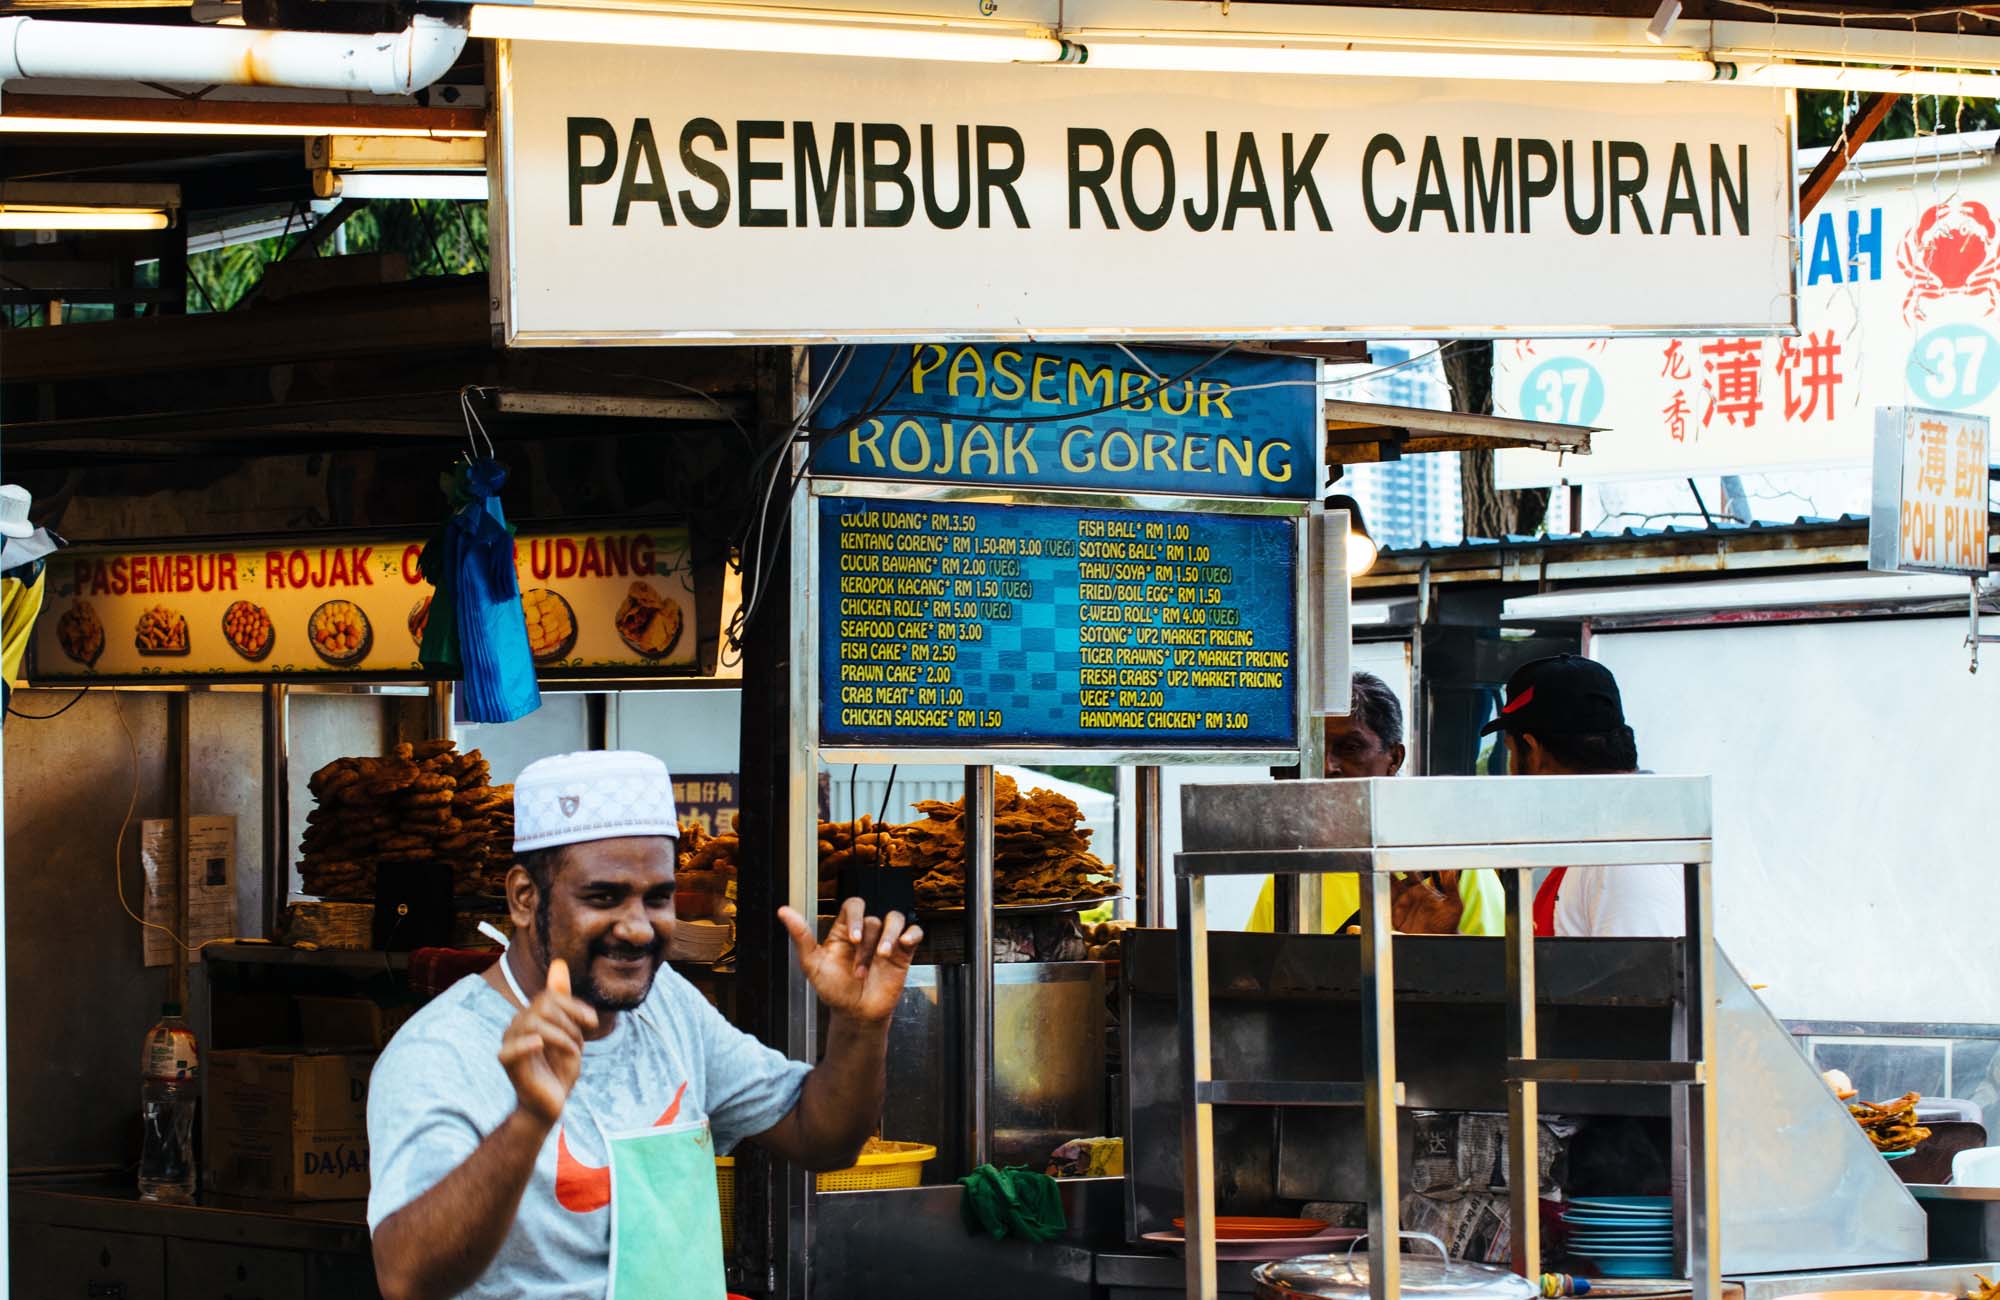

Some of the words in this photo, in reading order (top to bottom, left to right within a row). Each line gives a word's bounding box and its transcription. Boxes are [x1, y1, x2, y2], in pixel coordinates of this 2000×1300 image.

[567, 117, 1030, 229] PASEMBUR
[1068, 128, 1332, 232] ROJAK
[1363, 134, 1749, 235] CAMPURAN
[1800, 208, 1882, 286] AH
[1925, 336, 1988, 399] 37
[911, 344, 1233, 418] PASEMBUR
[1701, 329, 1842, 428] 薄饼
[1535, 368, 1589, 423] 37
[849, 419, 1038, 475] ROJAK
[1060, 426, 1292, 482] GORENG
[841, 512, 879, 528] CUCUR
[932, 515, 975, 531] RM.3.50
[1079, 521, 1104, 537] FISH
[1146, 524, 1163, 539] RM
[1167, 525, 1189, 540] 1.00
[1902, 501, 1936, 561] POH
[1944, 506, 1985, 567] PIAH
[841, 533, 893, 550] KENTANG
[953, 538, 970, 553] RM
[975, 538, 1016, 555] 1.50-RM
[1019, 540, 1041, 555] 3.00
[1045, 540, 1075, 557] (VEG)
[1079, 542, 1125, 559] SOTONG
[1167, 546, 1184, 561] RM
[1188, 546, 1210, 562] 1.00
[73, 553, 238, 596] PASEMBUR
[266, 547, 374, 589] ROJAK
[531, 534, 657, 580] UDANG
[841, 556, 879, 571] CUCUR
[942, 559, 960, 574] RM
[963, 560, 985, 575] 2.00
[990, 560, 1020, 576] (VEG)
[1155, 566, 1172, 581] RM
[1176, 567, 1198, 583] 1.50
[1202, 567, 1232, 584] (VEG)
[841, 577, 894, 594] KEROPOK
[955, 581, 972, 596] RM
[976, 581, 998, 597] 1.50
[1001, 582, 1032, 599] (VEG)
[1080, 584, 1143, 602] FRIED/BOIL
[1178, 588, 1195, 603] RM
[1199, 589, 1221, 604] 1.50
[841, 599, 890, 616] CHICKEN
[933, 602, 950, 618] RM
[954, 603, 976, 618] 5.00
[980, 603, 1012, 619] (VEG)
[1080, 605, 1121, 622] C-WEED
[1163, 608, 1180, 624] RM
[1183, 608, 1205, 624] 4.00
[1208, 609, 1240, 625] (VEG)
[841, 621, 894, 638] SEAFOOD
[938, 624, 955, 639] RM
[959, 625, 982, 640] 3.00
[1137, 629, 1158, 644] UP2
[1161, 629, 1207, 645] MARKET
[1210, 630, 1253, 646] PRICING
[841, 644, 868, 660] FISH
[912, 645, 929, 660] RM
[932, 645, 955, 661] 2.50
[1080, 648, 1113, 664] TIGER
[1174, 650, 1195, 666] UP2
[1198, 651, 1244, 666] MARKET
[1246, 652, 1289, 668] PRICING
[841, 665, 883, 682] PRAWN
[927, 667, 950, 683] 2.00
[1080, 670, 1116, 685] FRESH
[1167, 671, 1189, 687] UP2
[1192, 672, 1237, 688] MARKET
[1240, 672, 1282, 689] PRICING
[841, 687, 873, 703] CRAB
[919, 689, 936, 704] RM
[940, 689, 963, 705] 1.00
[1120, 691, 1164, 707] RM.2.00
[841, 709, 892, 726] CHICKEN
[958, 711, 975, 727] RM
[979, 711, 1001, 727] 1.50
[1080, 711, 1144, 728] HANDMADE
[1206, 713, 1223, 728] RM
[1226, 713, 1248, 729] 3.00
